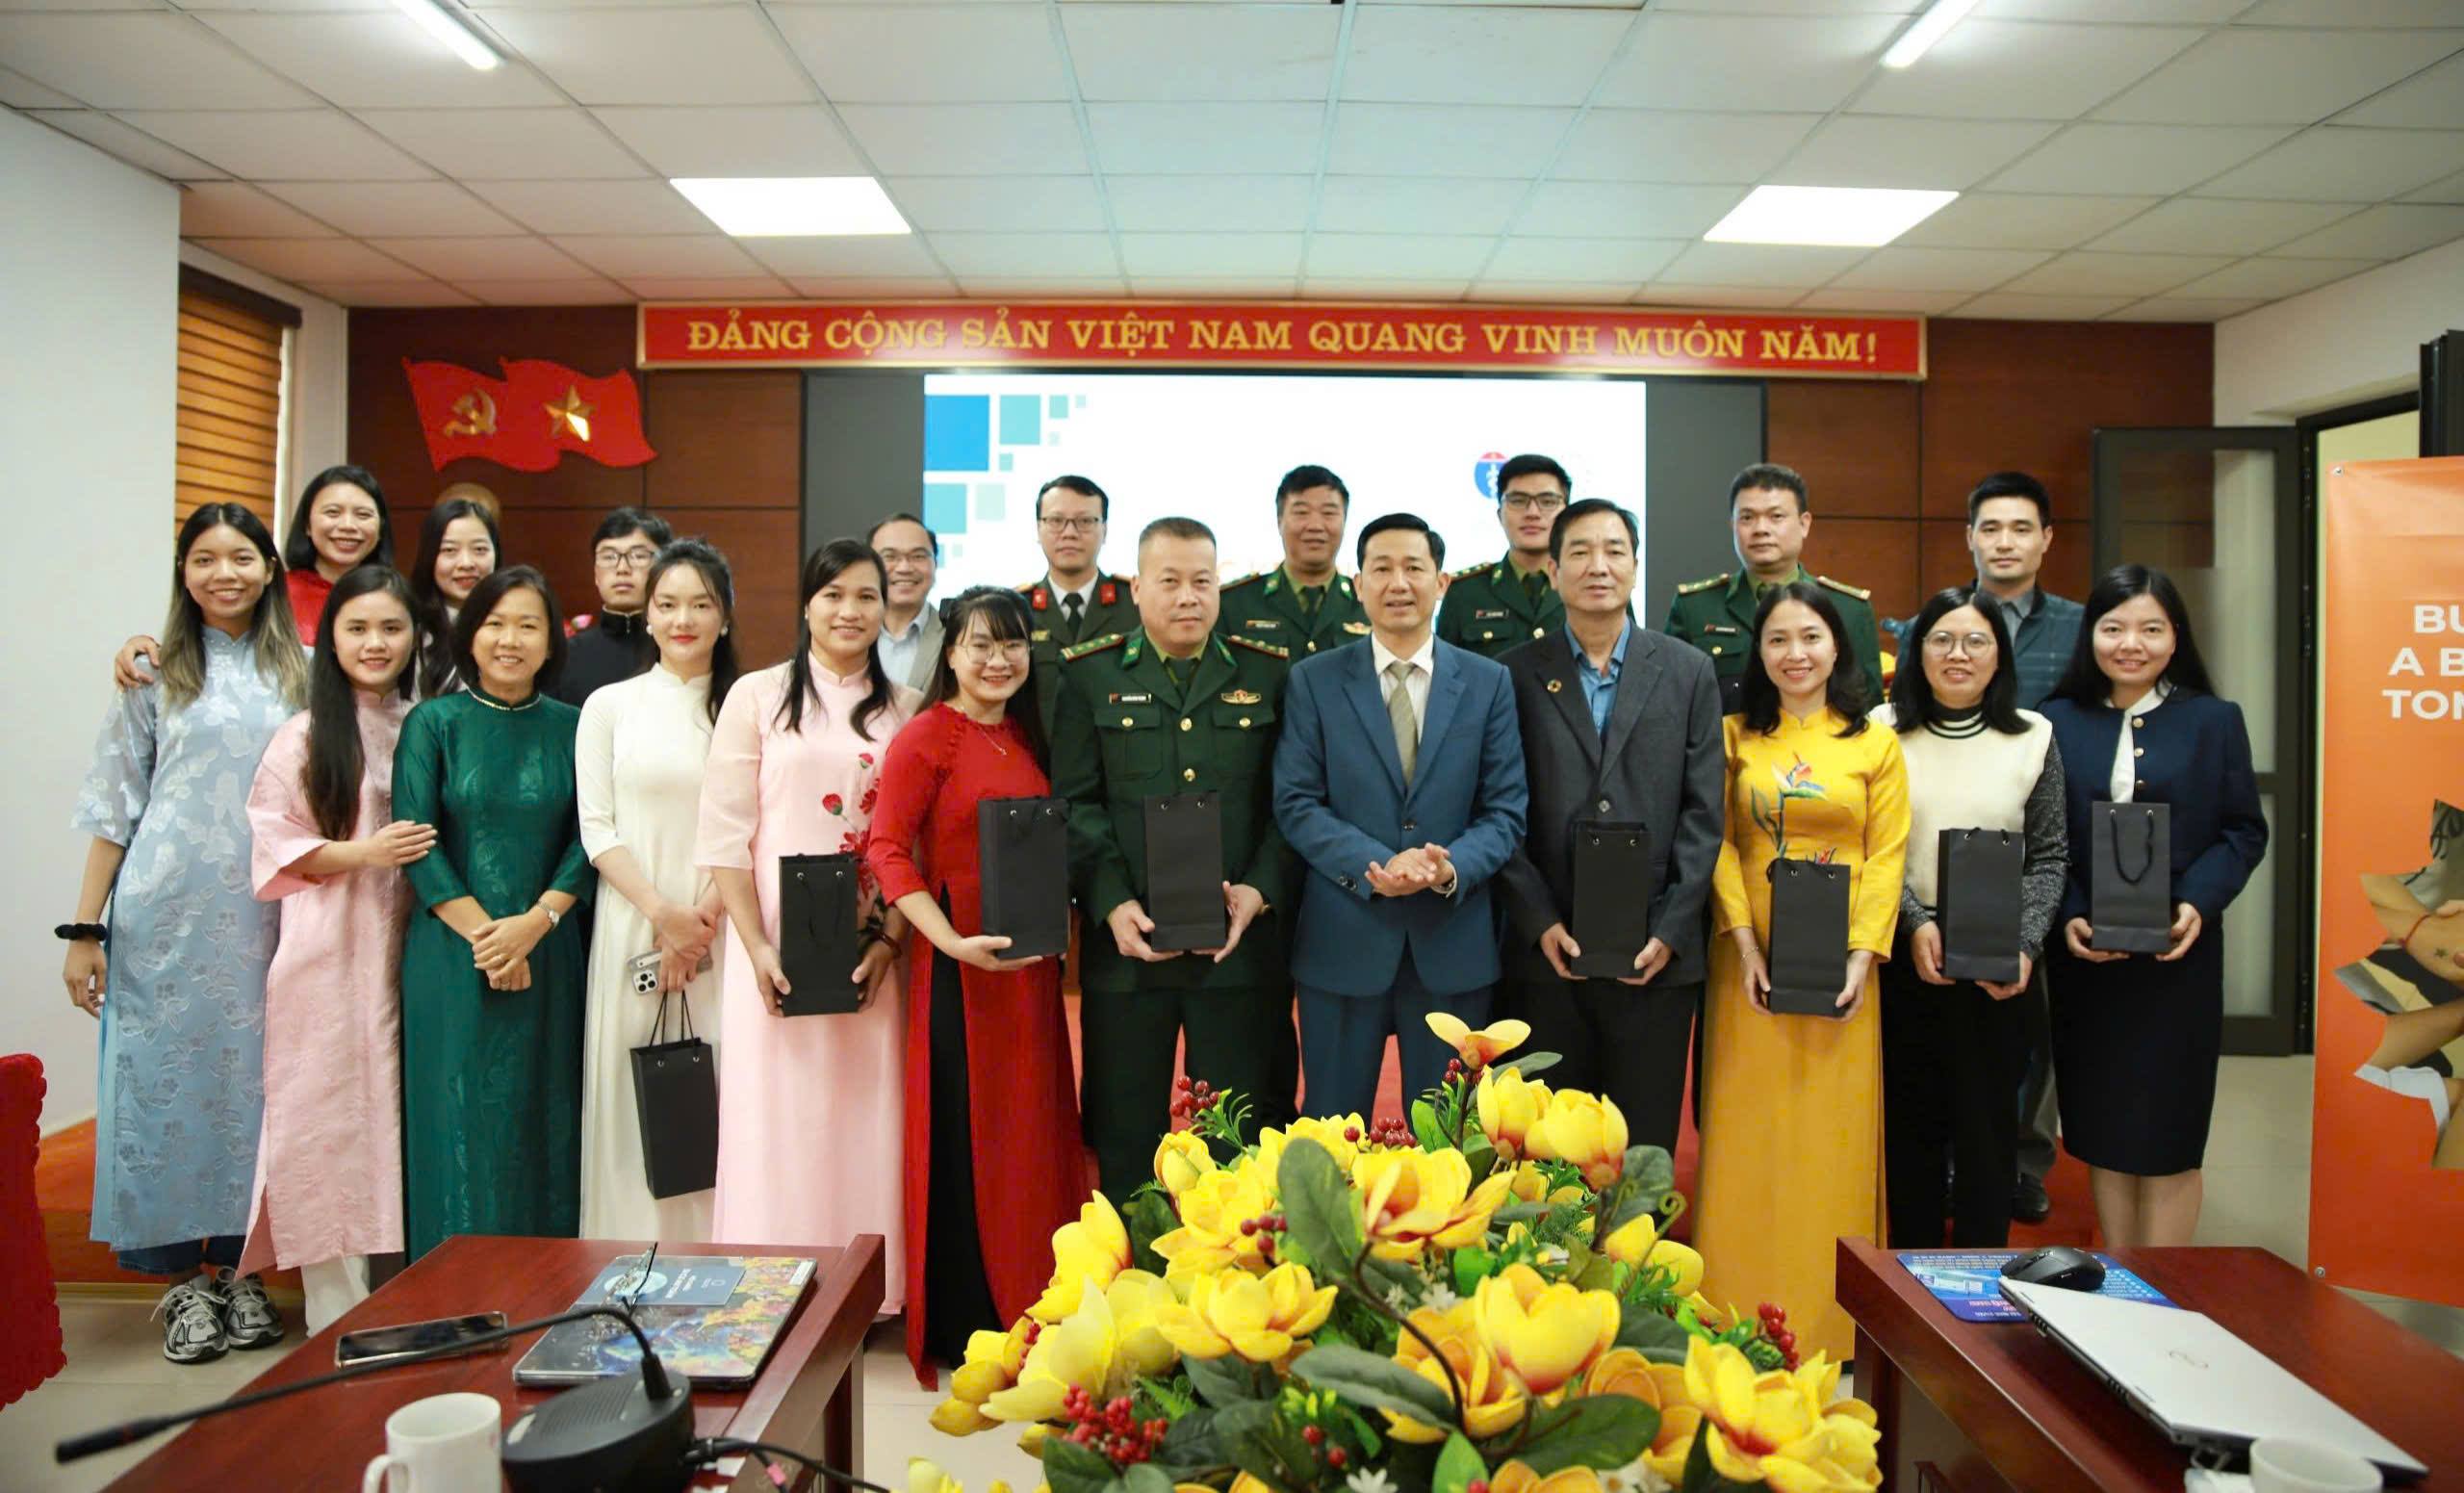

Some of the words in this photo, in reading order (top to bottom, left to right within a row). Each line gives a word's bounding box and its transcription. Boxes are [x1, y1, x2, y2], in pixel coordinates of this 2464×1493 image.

[687, 309, 811, 349] ĐẢNG
[824, 311, 947, 355] CỘNG
[962, 308, 1051, 349] SẢN
[1067, 312, 1174, 356] VIỆT
[1189, 321, 1292, 349] NAM
[1308, 322, 1466, 353] QUANG
[1481, 324, 1597, 355] VINH
[1614, 321, 1745, 359] MUÔN
[1759, 324, 1877, 362] NĂM!
[2387, 647, 2426, 677] A
